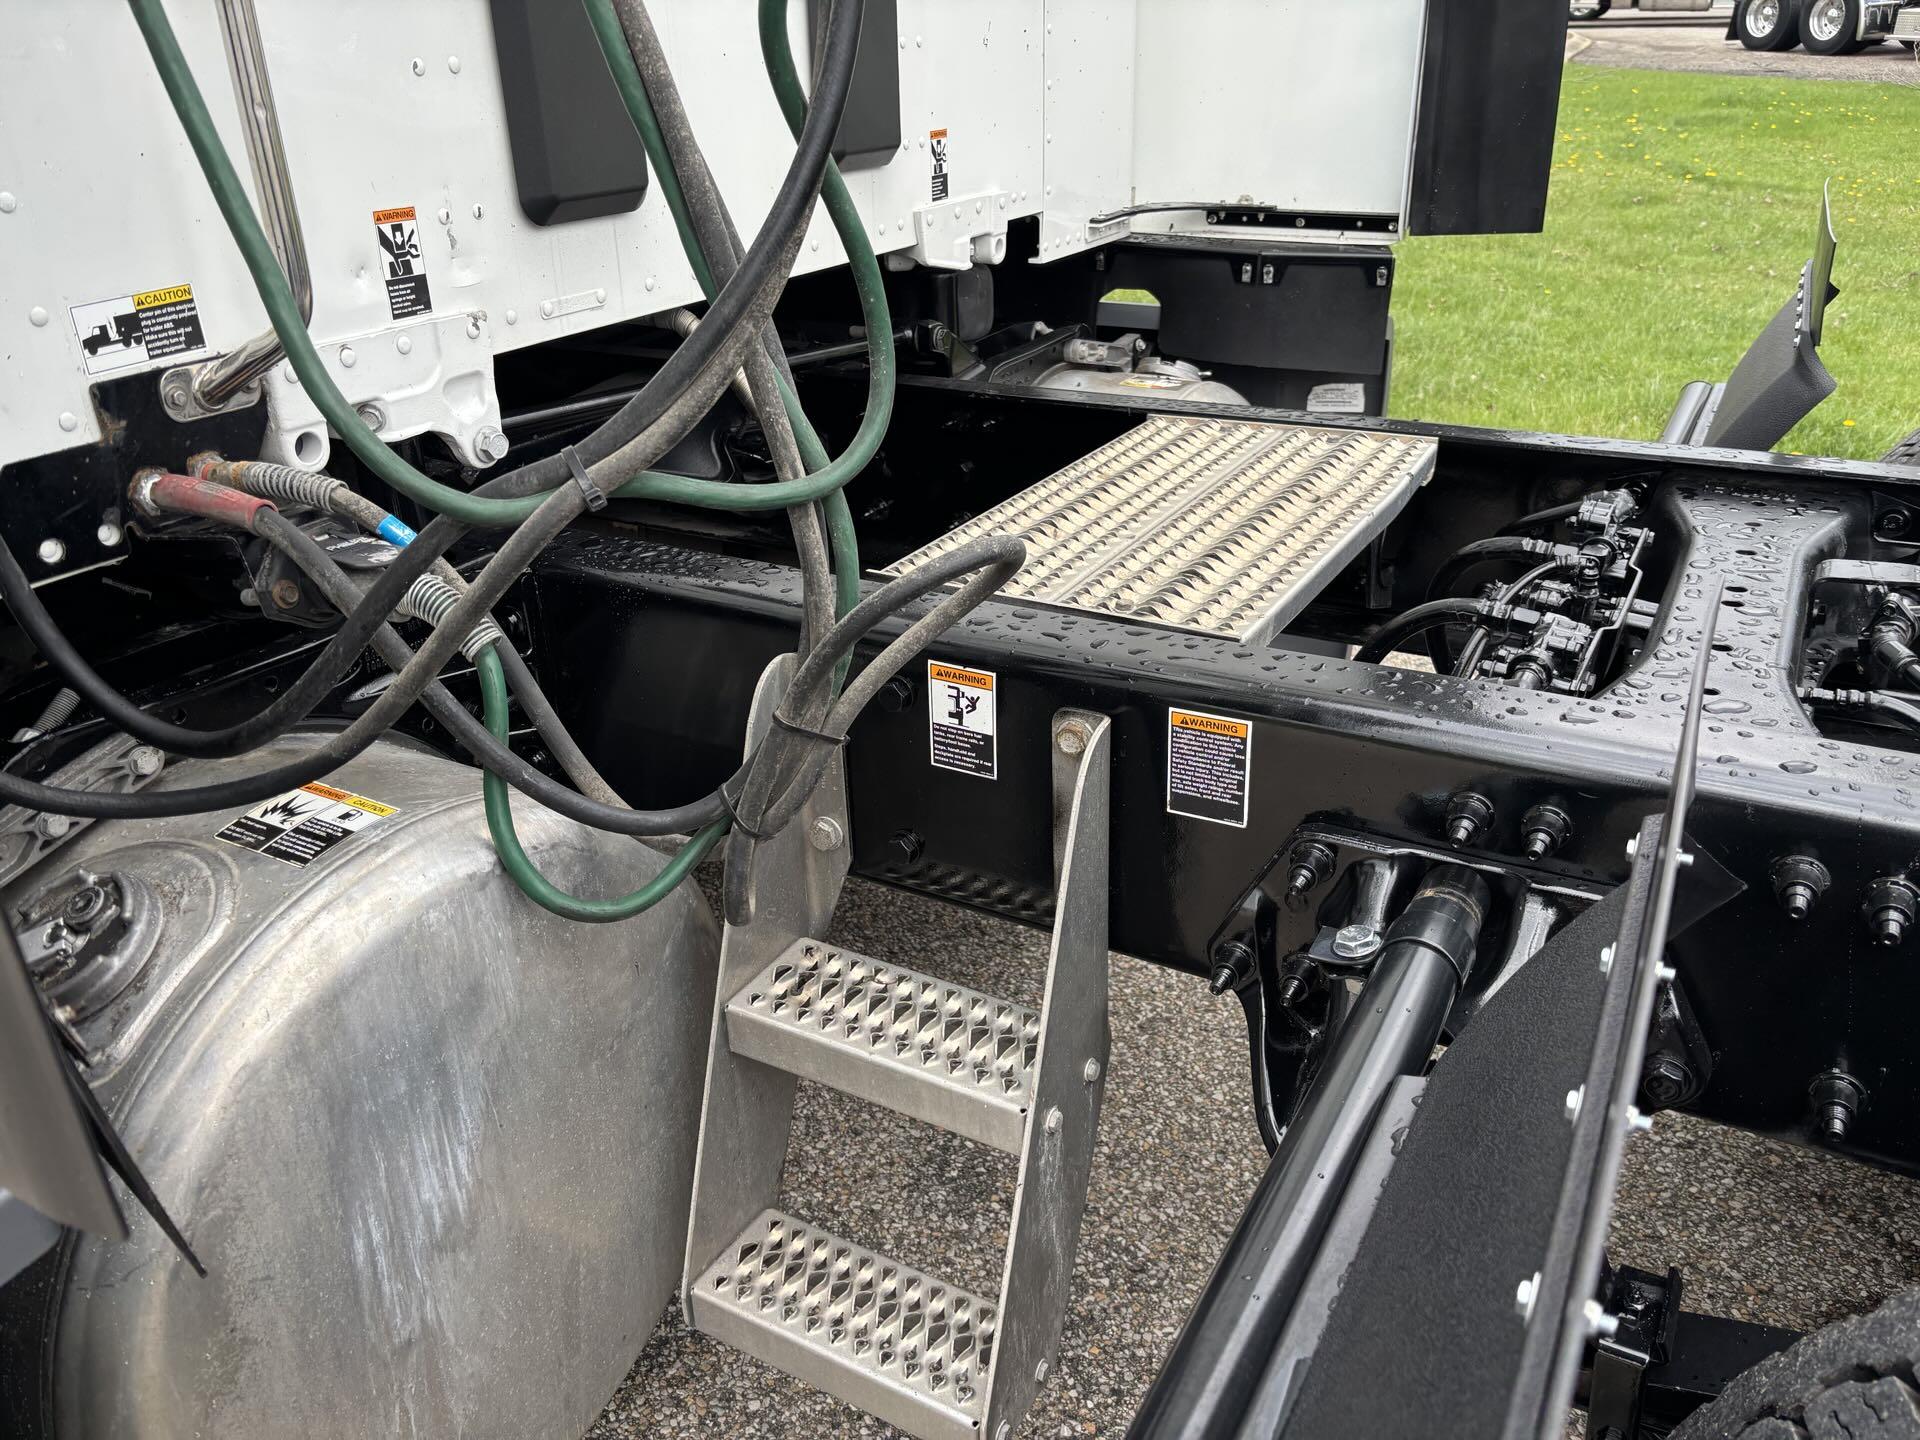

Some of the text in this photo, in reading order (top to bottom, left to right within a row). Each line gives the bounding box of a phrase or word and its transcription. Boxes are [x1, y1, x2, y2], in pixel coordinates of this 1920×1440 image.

[383, 210, 414, 220] WARNING
[145, 287, 192, 304] CAUTION
[943, 670, 987, 686] WARNING
[1189, 718, 1238, 734] WARNING
[353, 800, 388, 814] CAUTION
